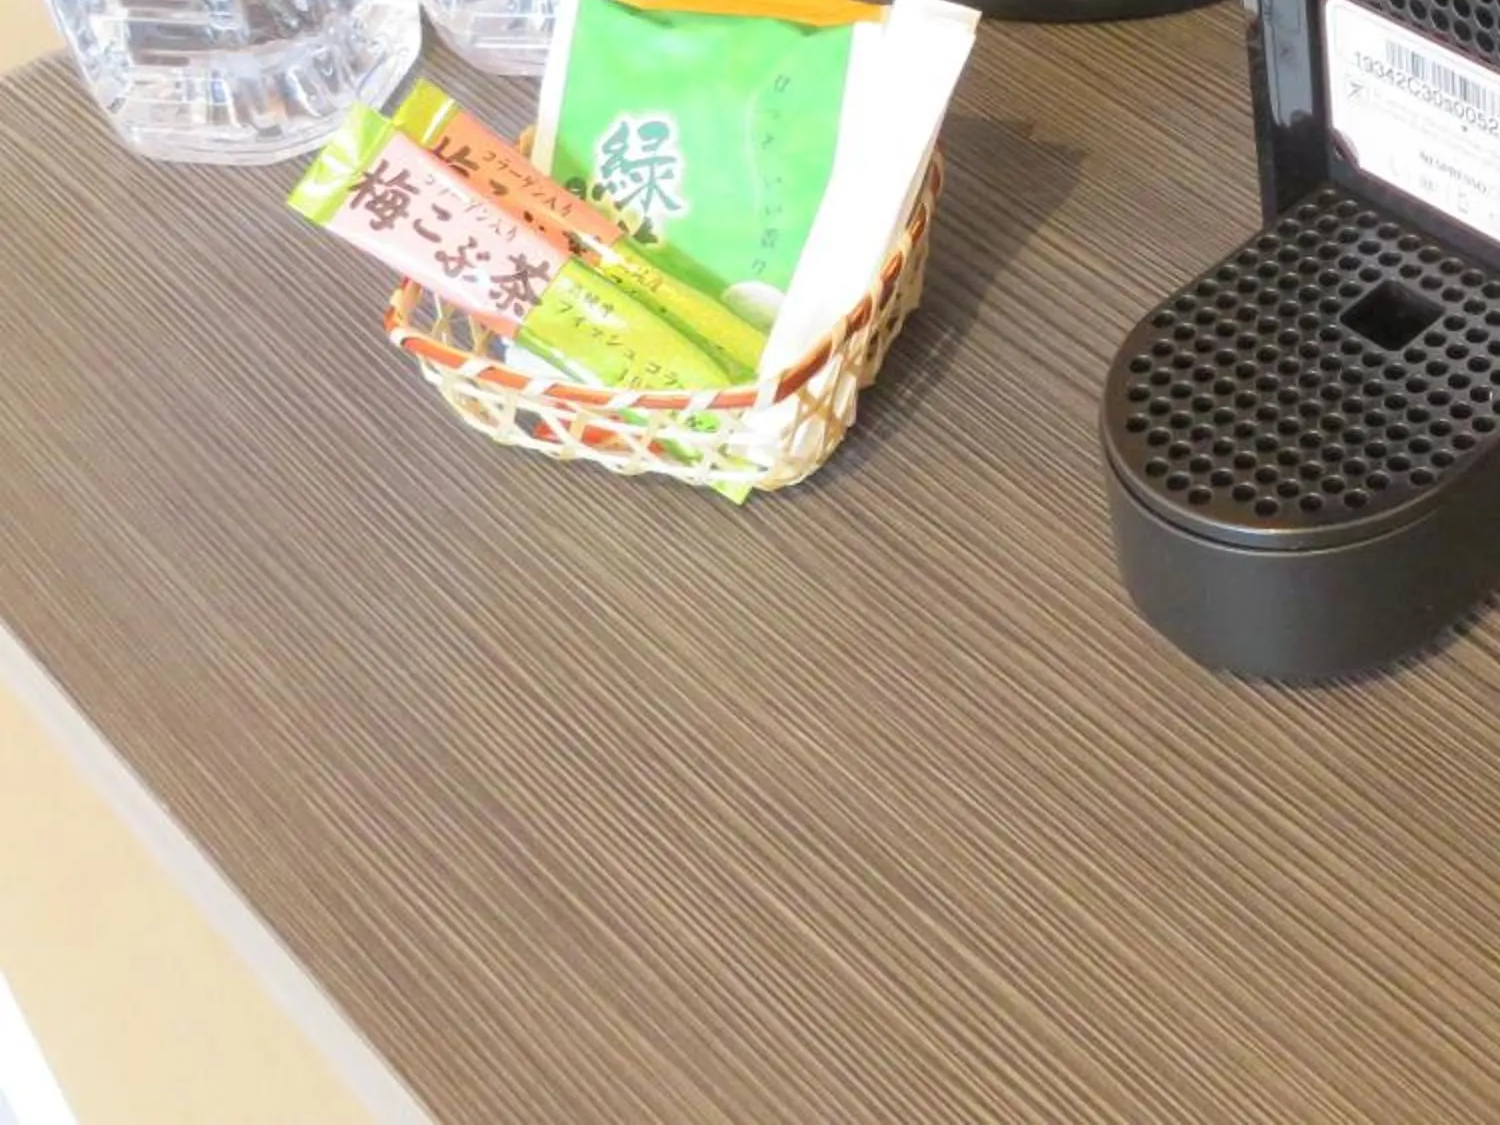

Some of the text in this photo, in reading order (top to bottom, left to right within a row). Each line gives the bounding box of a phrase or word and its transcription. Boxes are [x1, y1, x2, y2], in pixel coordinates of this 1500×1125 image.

[601, 121, 682, 213] 緑
[349, 158, 542, 318] 梅こぶ茶
